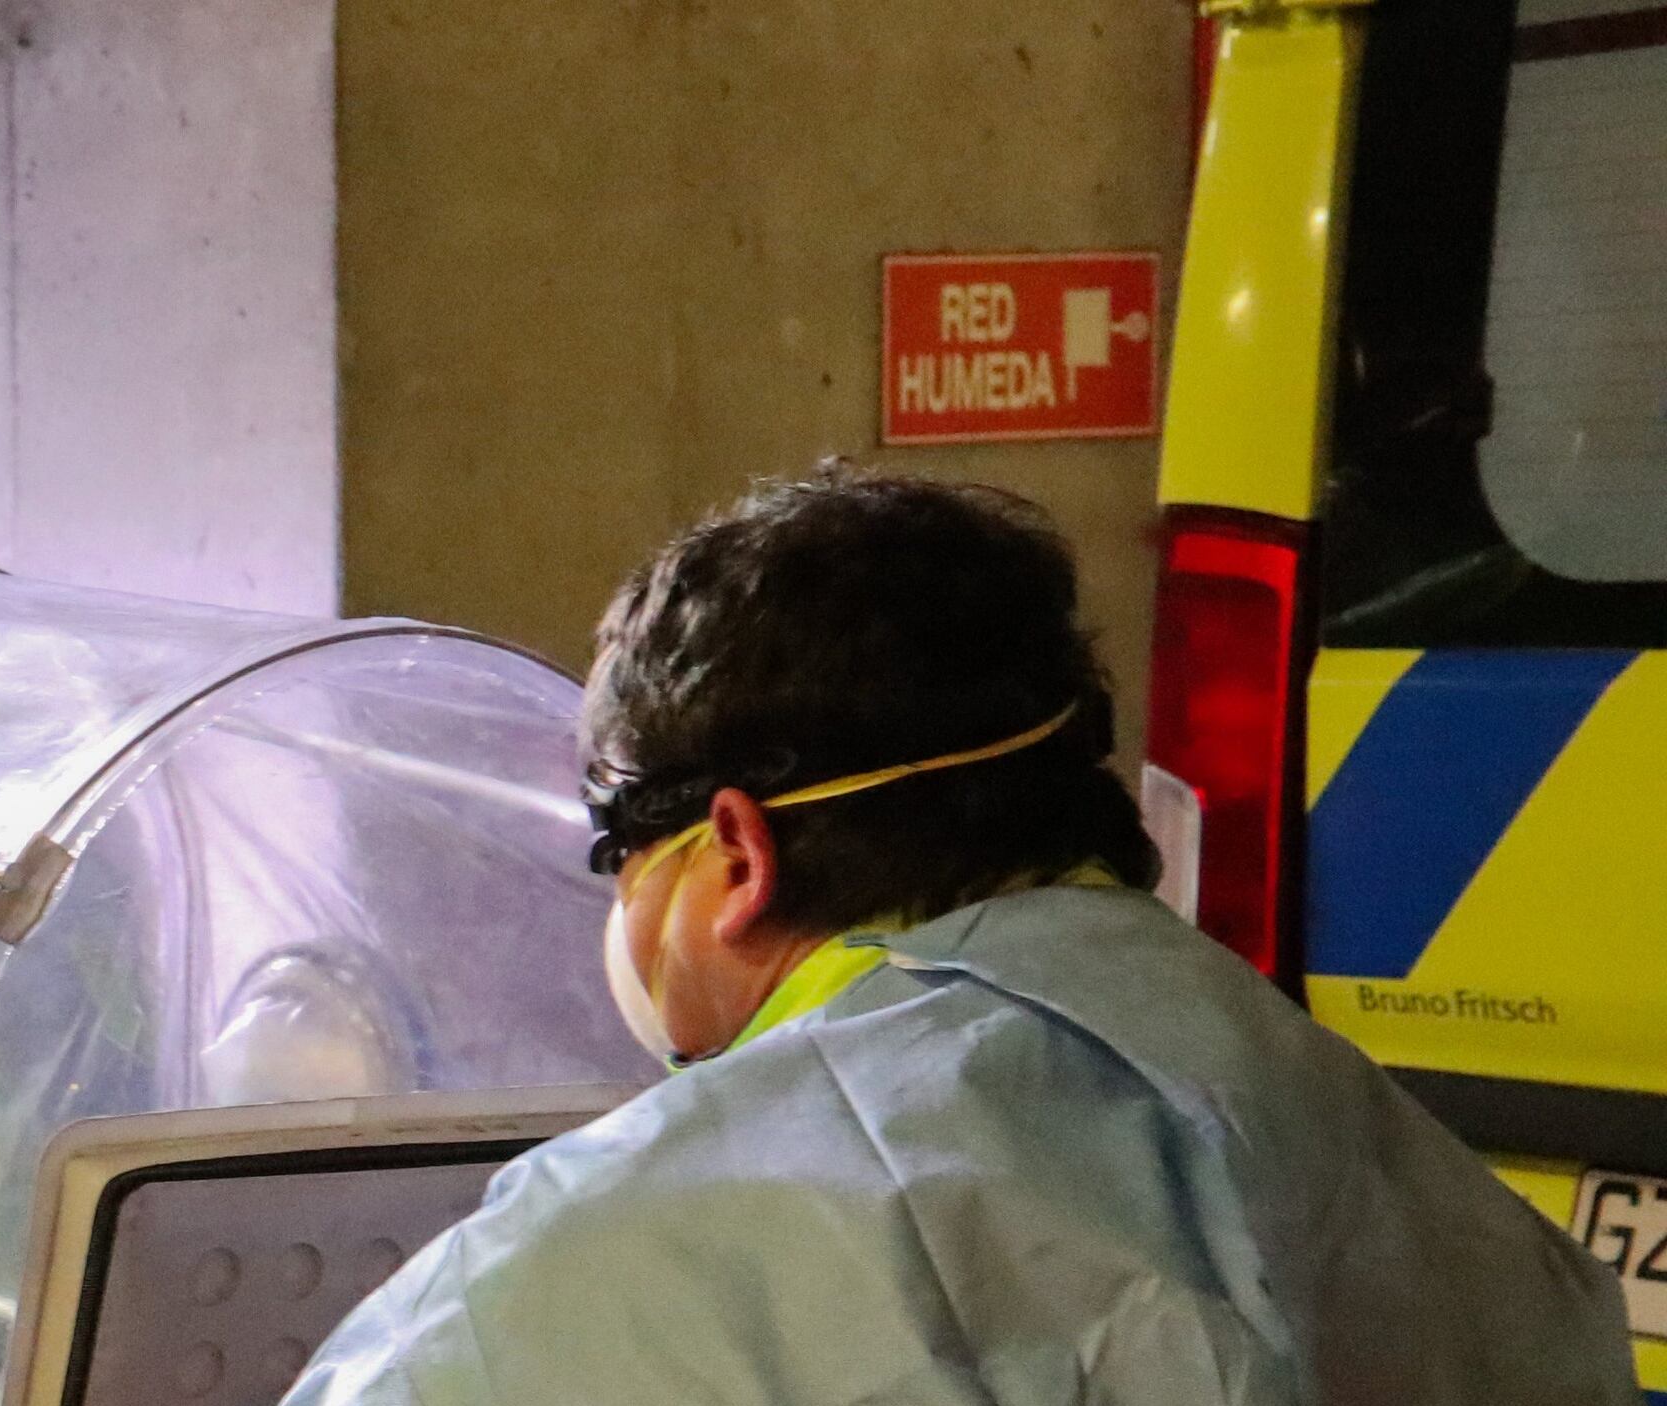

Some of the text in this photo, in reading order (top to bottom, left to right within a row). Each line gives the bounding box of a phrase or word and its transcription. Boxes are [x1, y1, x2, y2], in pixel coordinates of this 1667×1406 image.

[941, 283, 1016, 343] RED
[899, 351, 1056, 413] HUMEDA
[1358, 984, 1557, 1024] Bruno Fritsch
